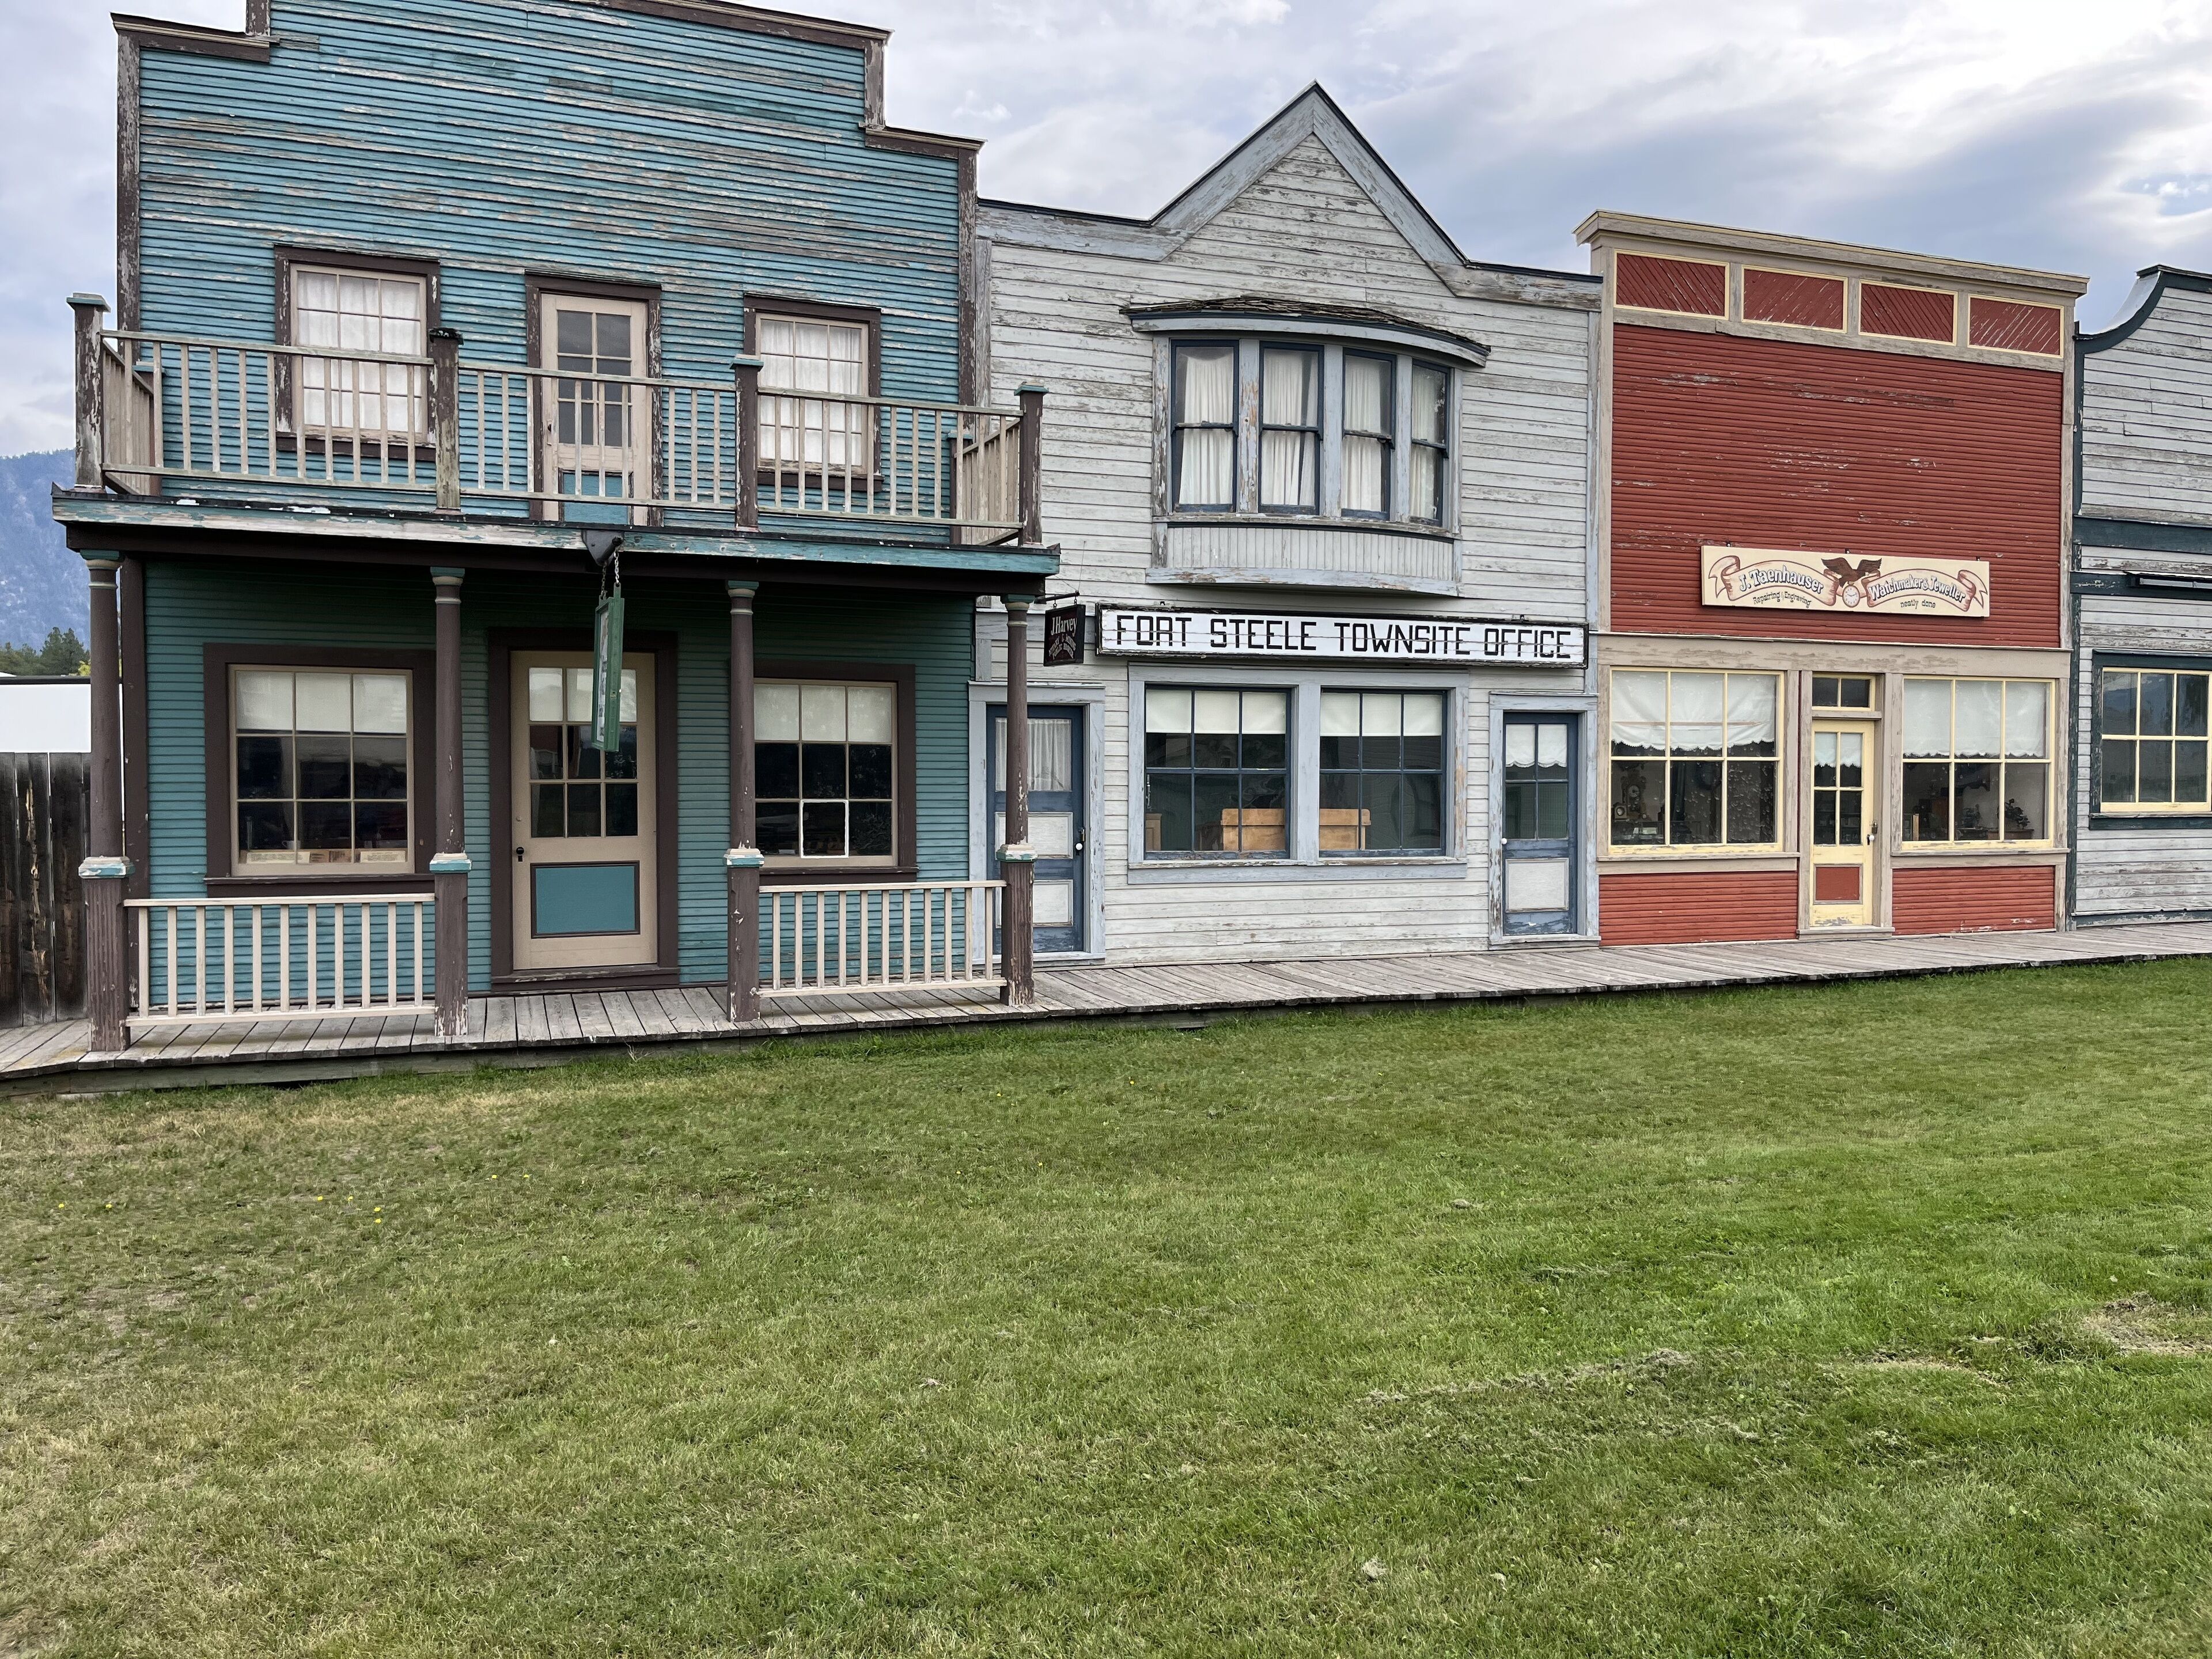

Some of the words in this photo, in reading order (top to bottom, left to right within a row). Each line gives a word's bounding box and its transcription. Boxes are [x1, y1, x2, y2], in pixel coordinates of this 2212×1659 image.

[1738, 575, 1751, 592] J.
[1749, 564, 1824, 594] Taenhauser
[1929, 575, 1965, 603] Jeweller
[1752, 592, 1781, 605] Repairing
[1784, 591, 1812, 608] Engraving
[1900, 600, 1919, 609] neatly
[1117, 615, 1192, 647] FORT
[1210, 618, 1317, 650] STEELE
[1334, 622, 1471, 655] TOWNSITE
[1484, 628, 1571, 659] OFFICE
